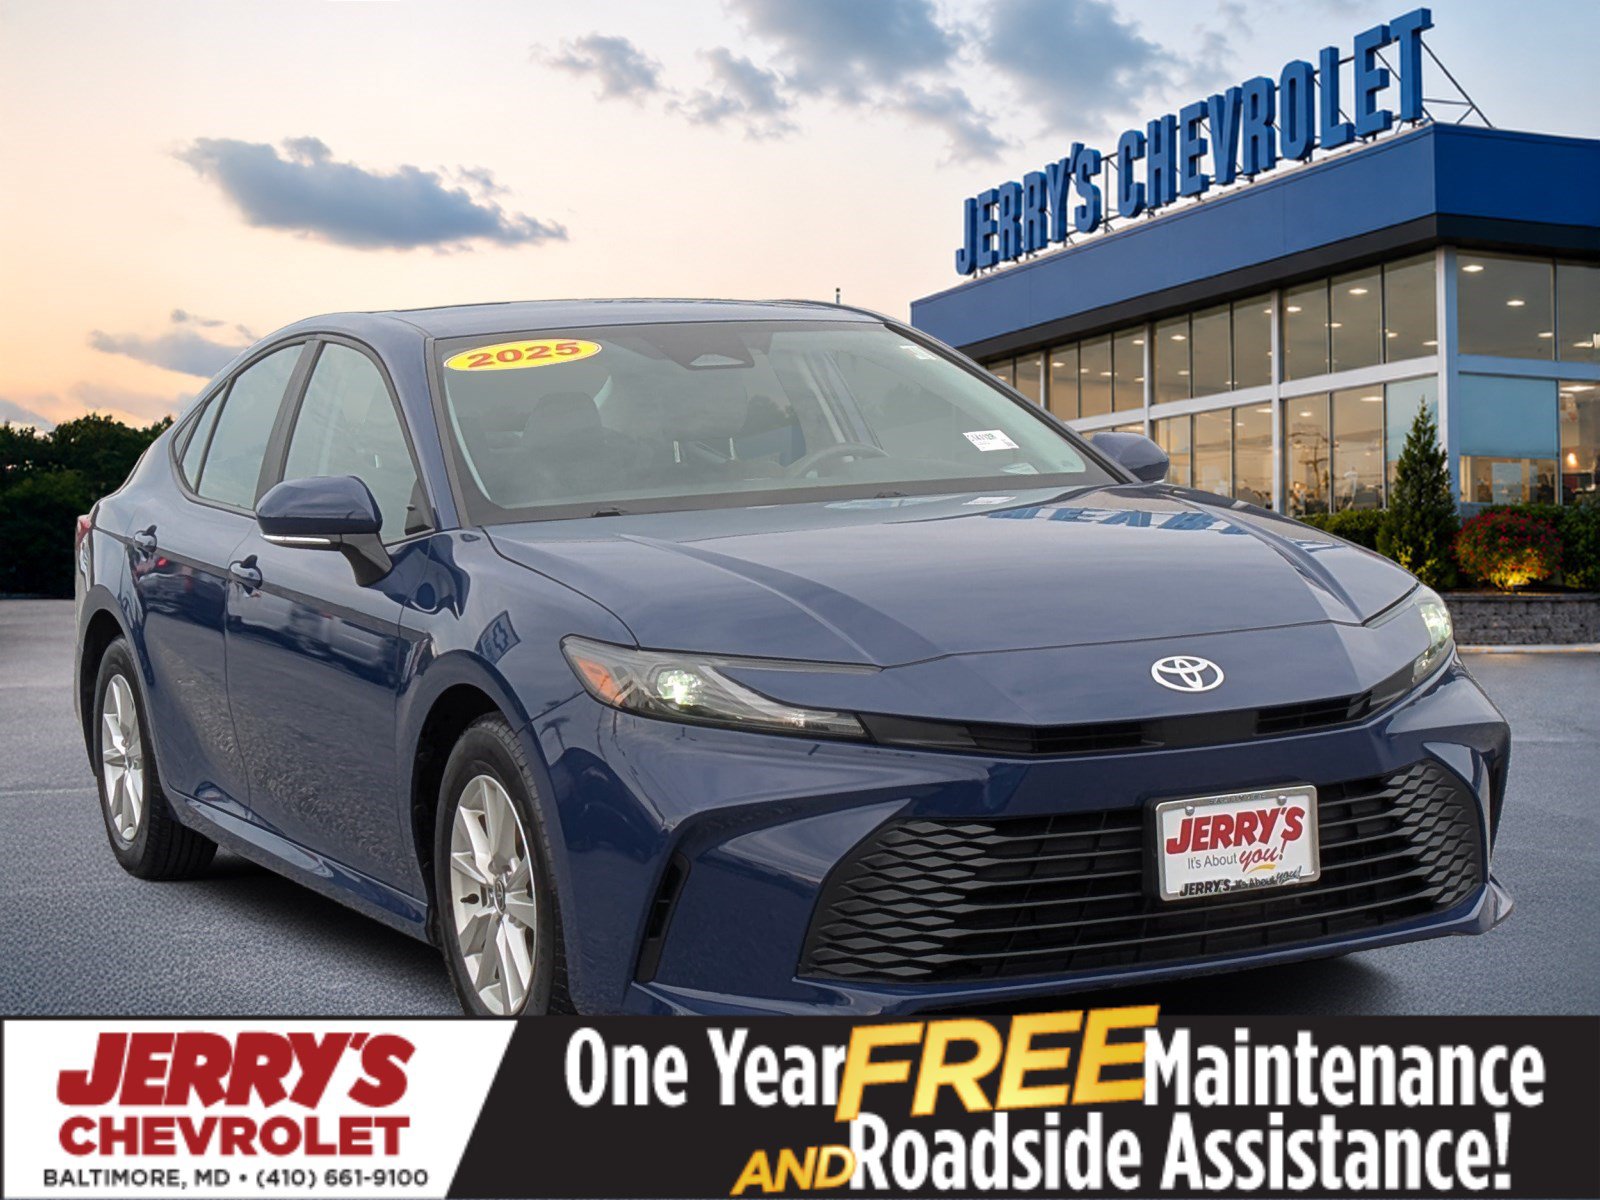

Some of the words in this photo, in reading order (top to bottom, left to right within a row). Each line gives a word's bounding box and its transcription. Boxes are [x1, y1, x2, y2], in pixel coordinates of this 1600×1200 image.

[955, 142, 1102, 276] JERRY'S
[1117, 7, 1434, 219] CHEVROLET
[467, 342, 581, 368] 2025
[1166, 806, 1305, 855] JERRY'S
[1188, 857, 1201, 869] It's
[1204, 854, 1237, 867] About
[1239, 840, 1286, 873] you!
[1180, 879, 1231, 896] JERRY'S
[1248, 875, 1276, 889] About
